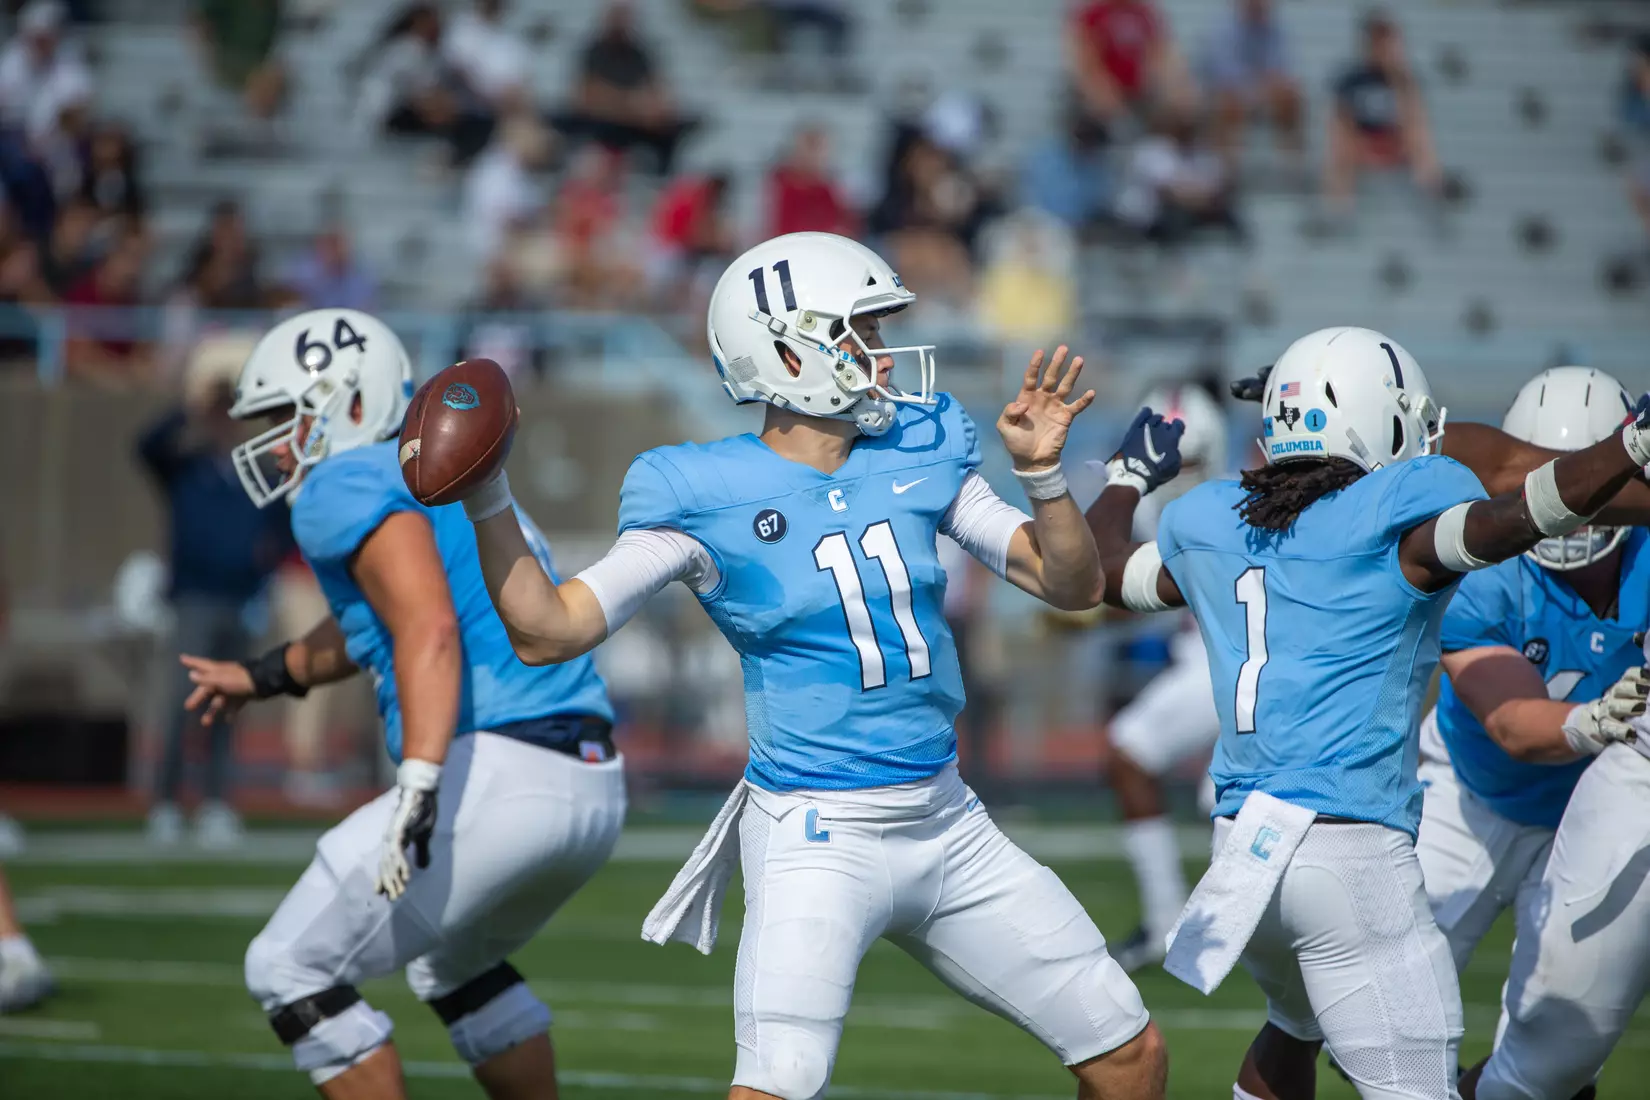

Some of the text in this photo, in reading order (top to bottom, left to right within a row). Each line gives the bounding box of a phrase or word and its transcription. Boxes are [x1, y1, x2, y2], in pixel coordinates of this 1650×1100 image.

[748, 259, 798, 316] 11
[296, 319, 366, 372] 64
[1379, 342, 1405, 390] 1
[1312, 413, 1318, 427] 1
[1271, 440, 1324, 455] COLUMBIA
[827, 488, 849, 513] C
[757, 513, 778, 537] 67
[811, 518, 932, 694] 11
[1234, 565, 1269, 735] 1
[1590, 631, 1605, 653] C
[1250, 826, 1281, 861] C
